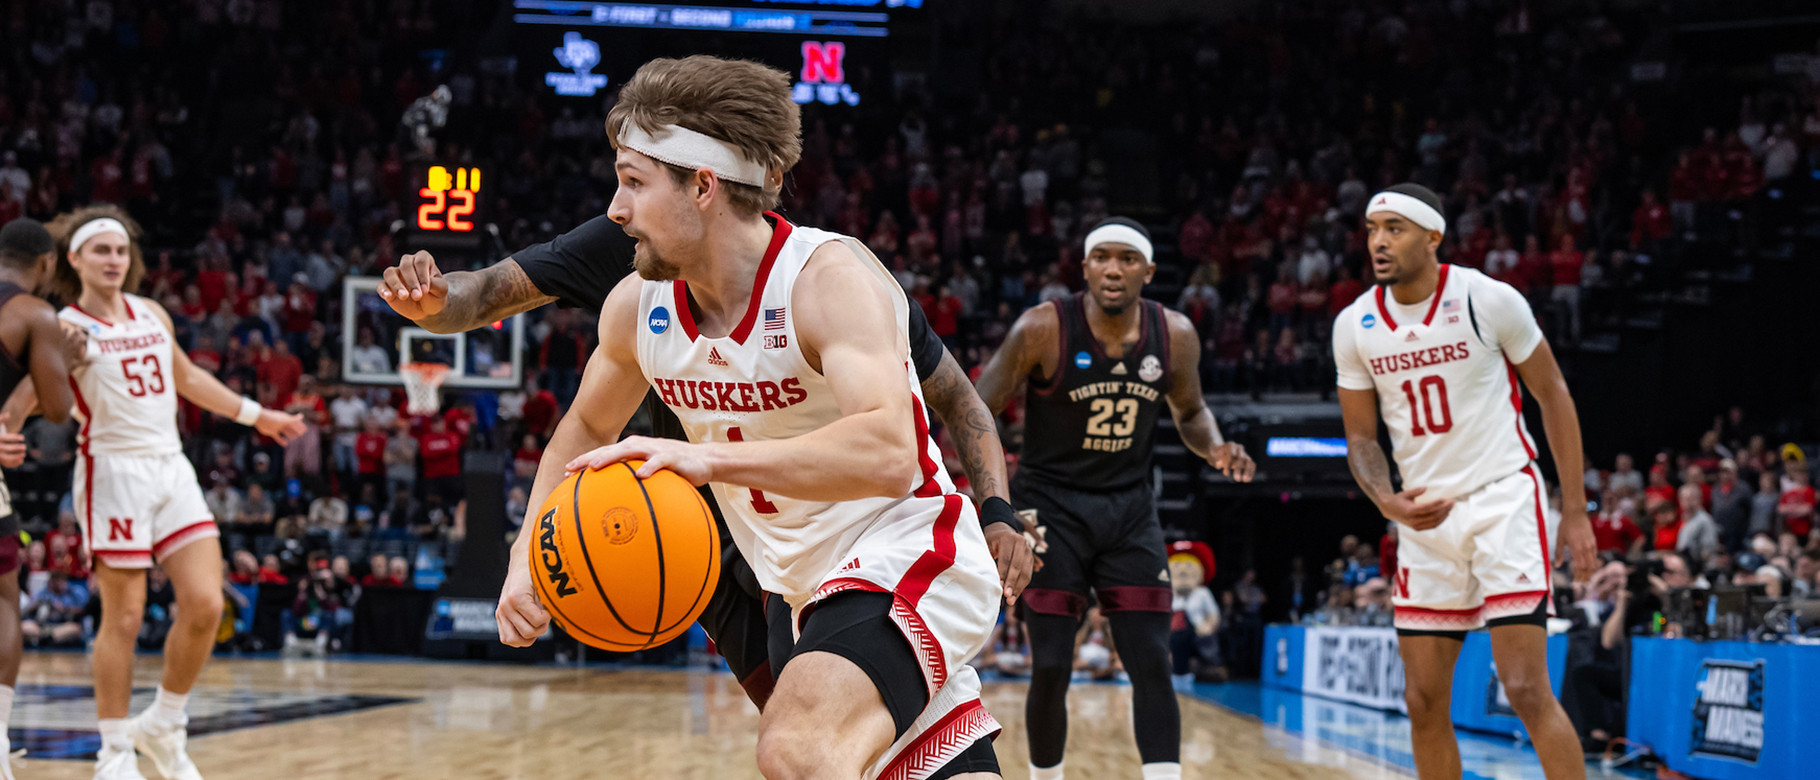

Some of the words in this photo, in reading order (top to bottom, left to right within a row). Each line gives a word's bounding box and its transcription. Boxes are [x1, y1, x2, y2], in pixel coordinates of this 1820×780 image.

[801, 41, 845, 83] N
[418, 187, 475, 232] 22
[121, 354, 165, 397] 53
[1370, 341, 1470, 376] HUSKERS
[654, 376, 808, 413] HUSKERS
[1125, 381, 1160, 402] TEXAS
[1401, 374, 1454, 437] 10
[1086, 398, 1139, 437] 23
[1082, 437, 1133, 453] AGGIES
[108, 517, 133, 541] N
[540, 504, 578, 599] NCAA
